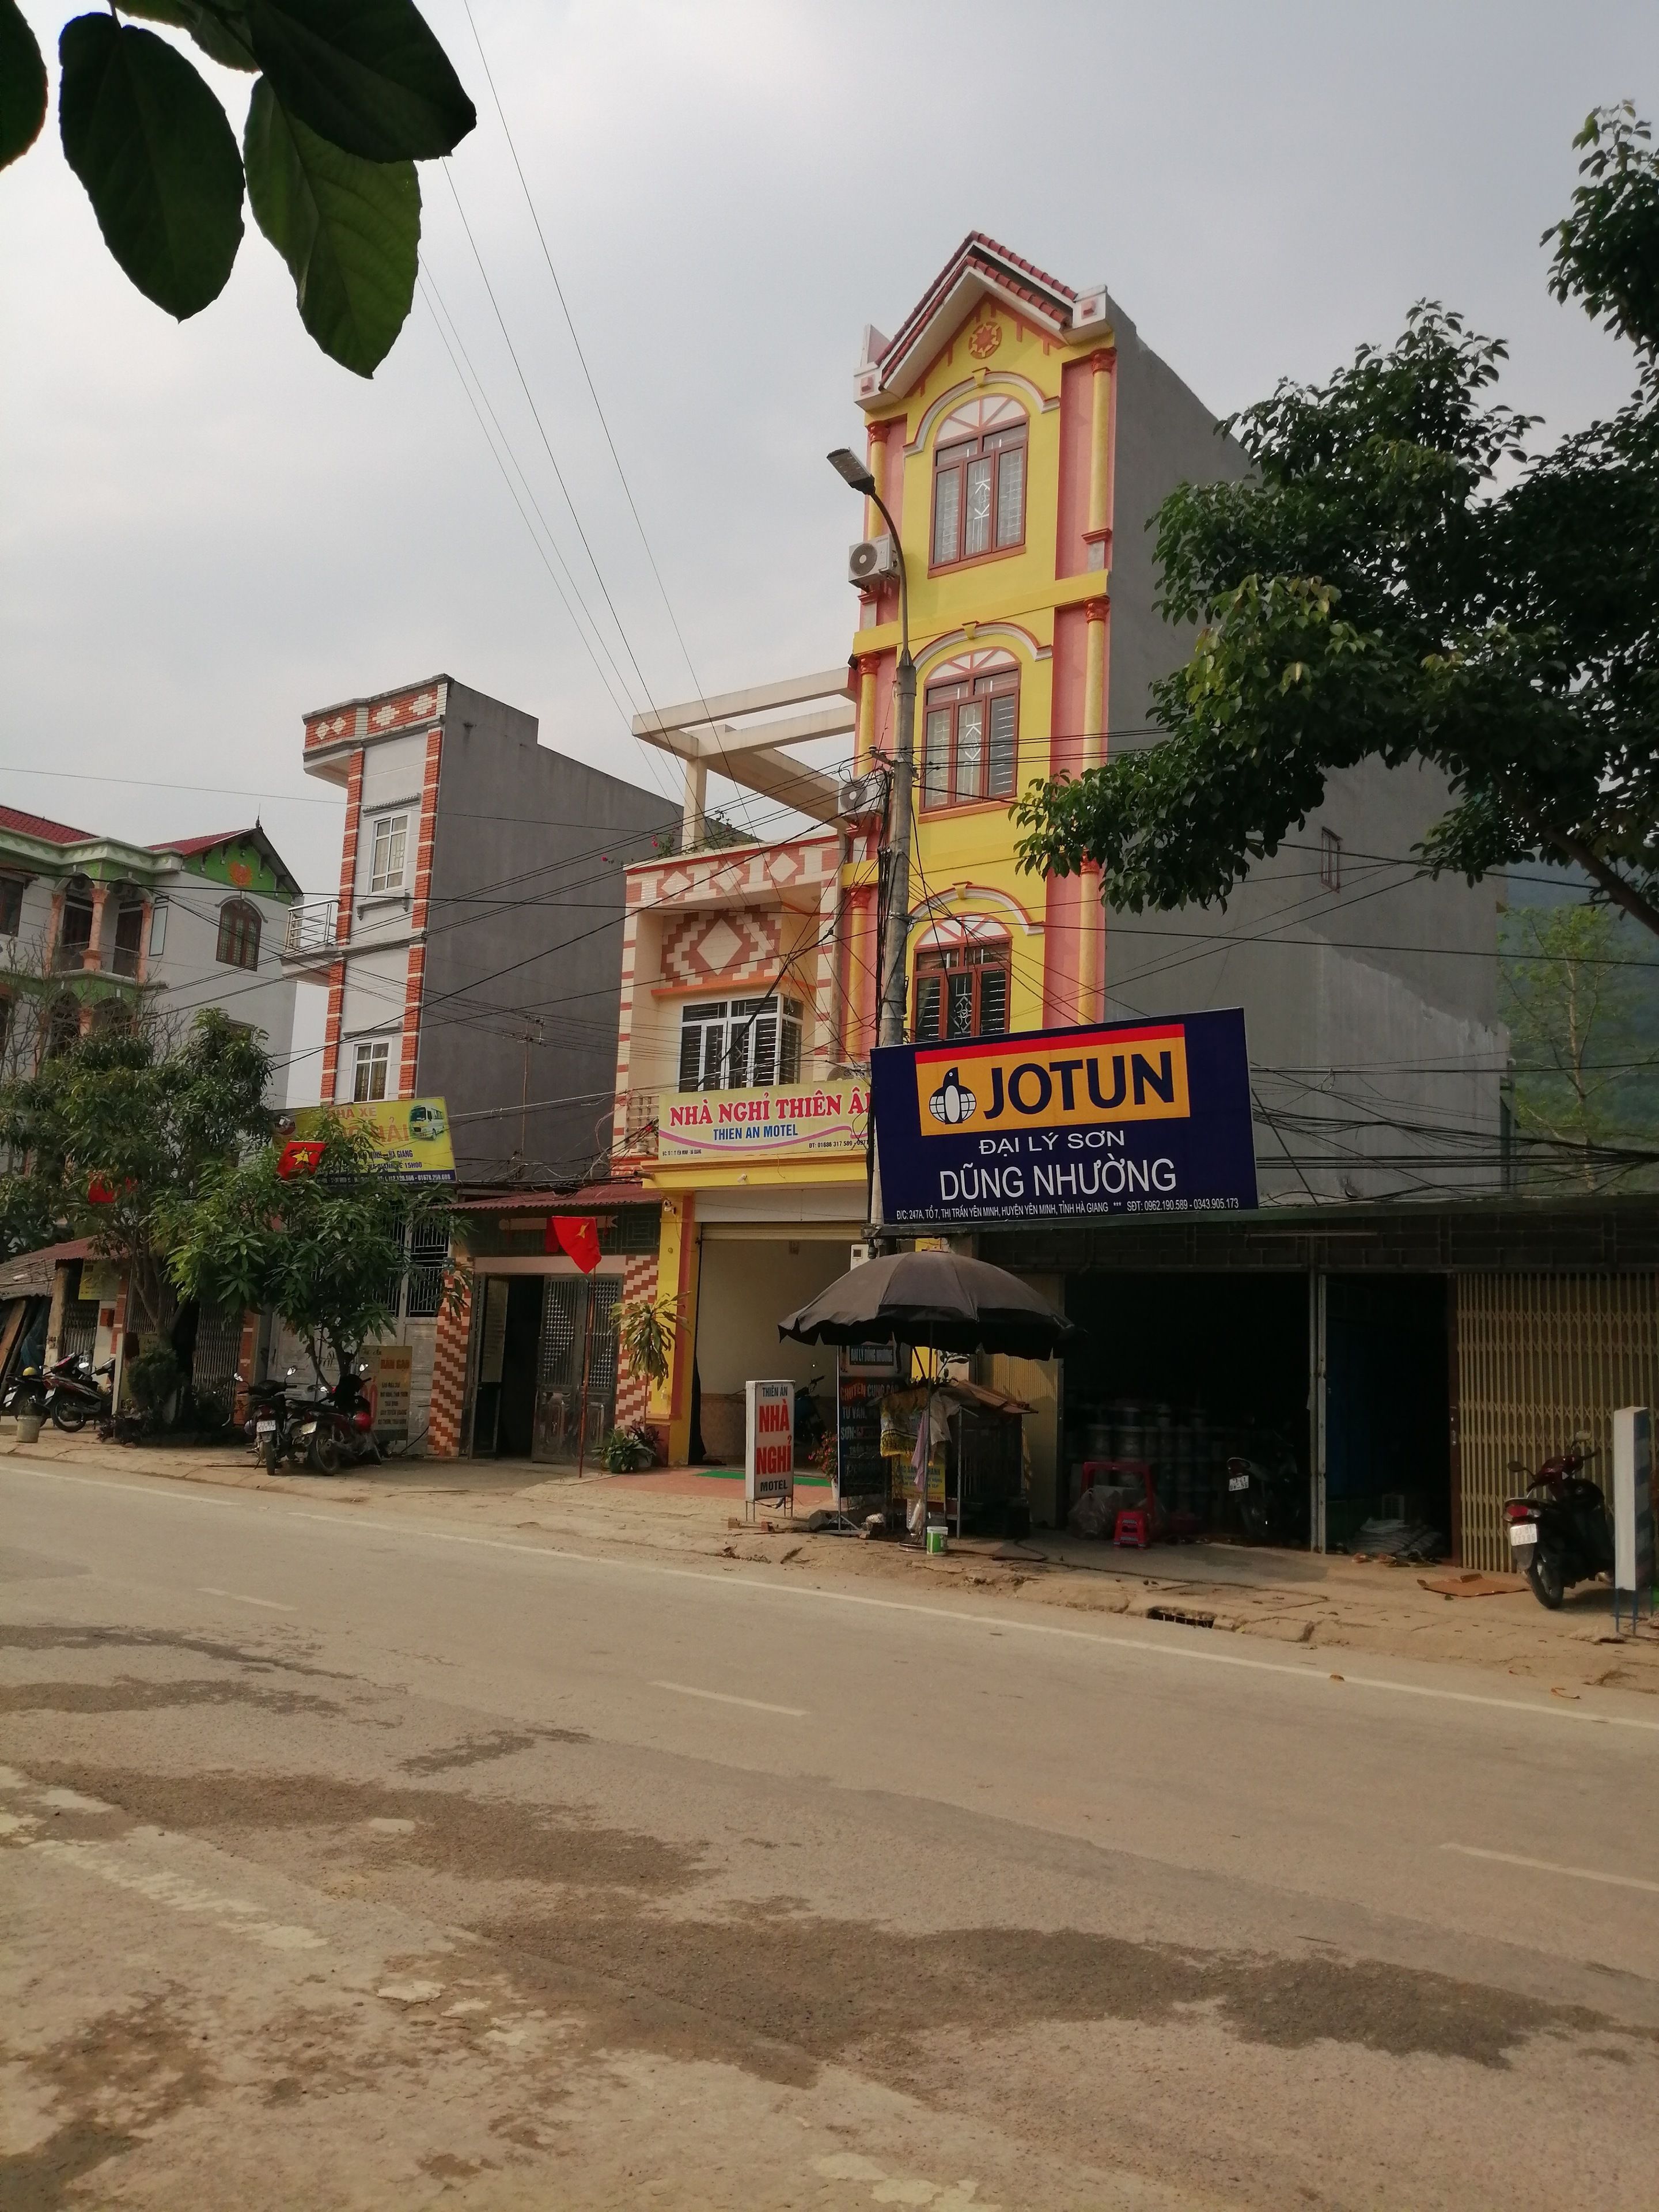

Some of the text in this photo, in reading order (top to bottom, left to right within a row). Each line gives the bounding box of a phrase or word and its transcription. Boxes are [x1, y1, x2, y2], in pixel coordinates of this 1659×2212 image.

[983, 1051, 1175, 1119] JOTUN
[359, 1107, 377, 1118] XE
[669, 1099, 713, 1127] NHÀ
[718, 1092, 770, 1124] NGHỈ
[775, 1090, 842, 1120] THIÊN
[713, 1123, 798, 1141] THIEN AN MOTEL
[979, 1129, 1126, 1158] ĐẠI LÝ SƠN
[397, 1150, 413, 1158] GIANG
[940, 1153, 1177, 1201] DŨNG NHƯỜNG
[896, 1210, 908, 1220] Đ/C:
[909, 1210, 925, 1220] 247A,
[925, 1205, 934, 1219] TỔ
[934, 1209, 941, 1219] 7,
[941, 1208, 951, 1220] THỊ
[952, 1205, 968, 1218] TRẤN
[969, 1205, 982, 1218] YÊN
[983, 1206, 1001, 1217] MINH,
[1001, 1203, 1024, 1218] HUYỆN
[1024, 1202, 1038, 1215] YÊN
[1039, 1203, 1058, 1215] MINH,
[1058, 1200, 1074, 1214] TỈNH
[1075, 1200, 1085, 1213] HÀ
[1086, 1201, 1109, 1213] GIANG
[1127, 1200, 1143, 1211] SĐT:
[1144, 1199, 1188, 1211] 0962.190.589
[1193, 1198, 1239, 1210] 0343.905.173
[762, 1385, 779, 1397] THIÊN
[759, 1398, 790, 1433] NHÀ
[756, 1434, 792, 1475] NGHỈ
[760, 1479, 788, 1492] MOTEL
